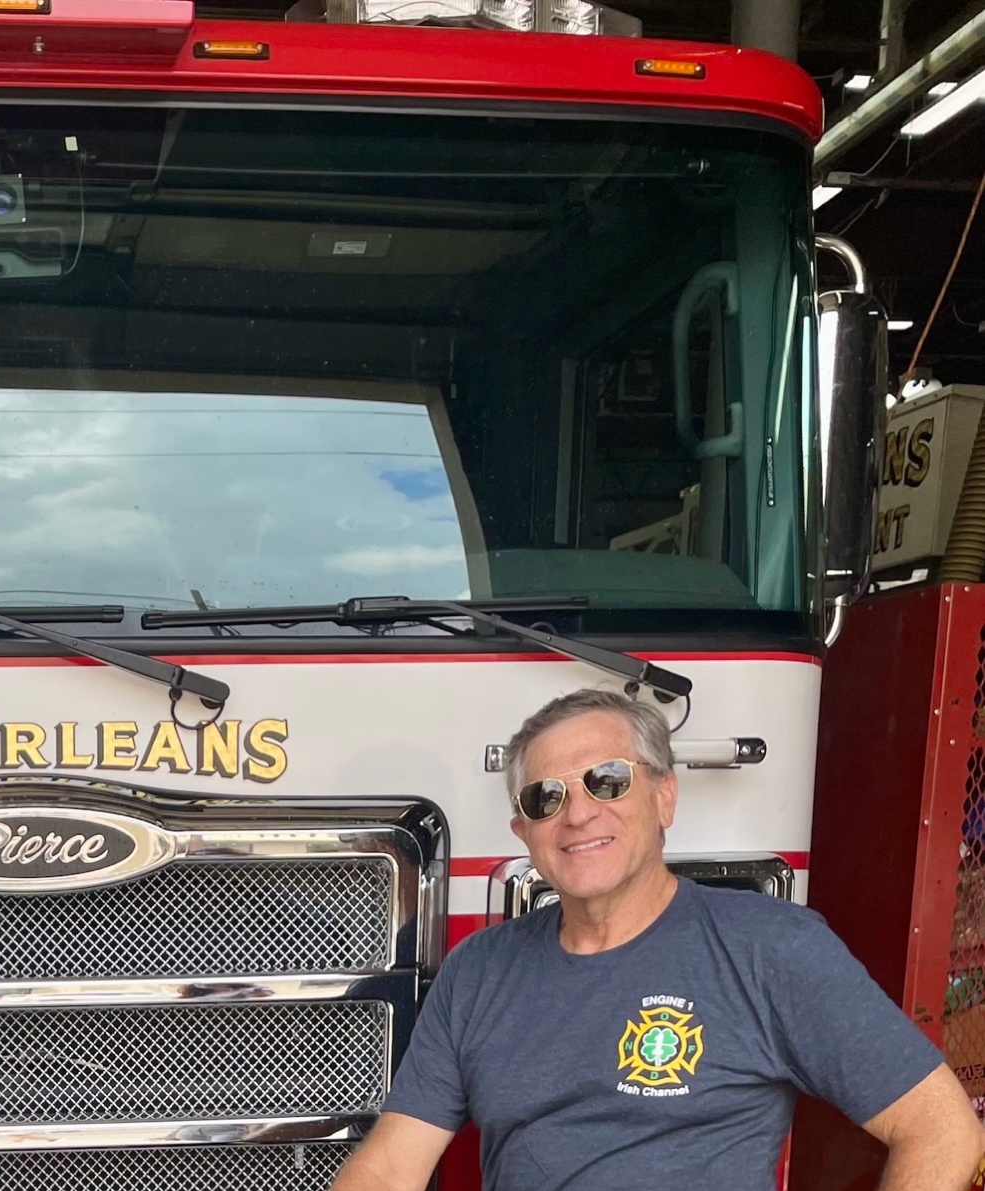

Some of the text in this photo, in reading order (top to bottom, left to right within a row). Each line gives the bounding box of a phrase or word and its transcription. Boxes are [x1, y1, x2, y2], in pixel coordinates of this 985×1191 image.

[642, 995, 694, 1011] ENGINE 1
[617, 1082, 689, 1096] Irish Channel
